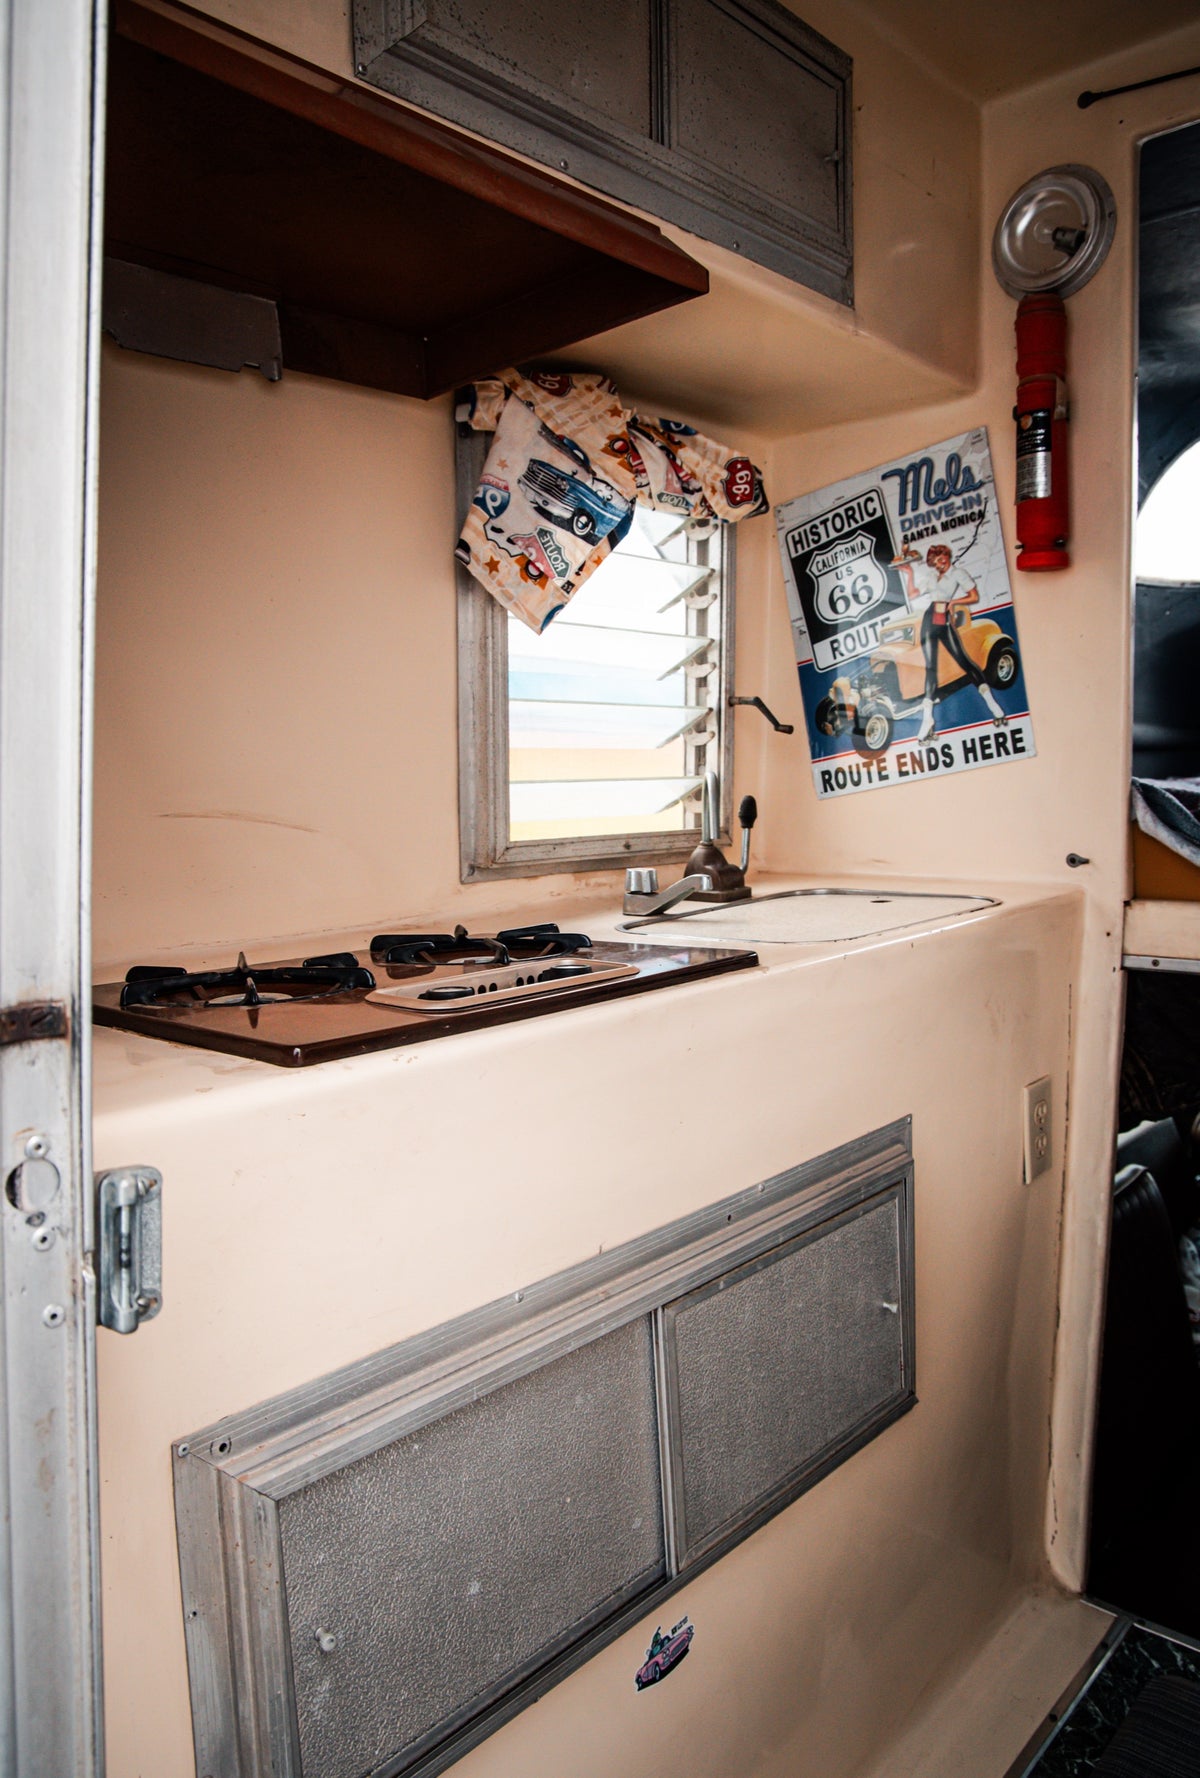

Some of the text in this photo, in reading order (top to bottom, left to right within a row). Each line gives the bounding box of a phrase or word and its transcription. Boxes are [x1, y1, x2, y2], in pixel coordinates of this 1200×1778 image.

[881, 453, 984, 516] Mels
[791, 496, 877, 554] HISTORIC
[900, 493, 982, 532] DRIVE-IN
[903, 509, 985, 545] SANTA MONICA
[816, 540, 866, 573] CALIFORNIA
[835, 566, 854, 581] US
[828, 574, 874, 615] 66
[821, 728, 1027, 793] ROUTE ENDS HERE
